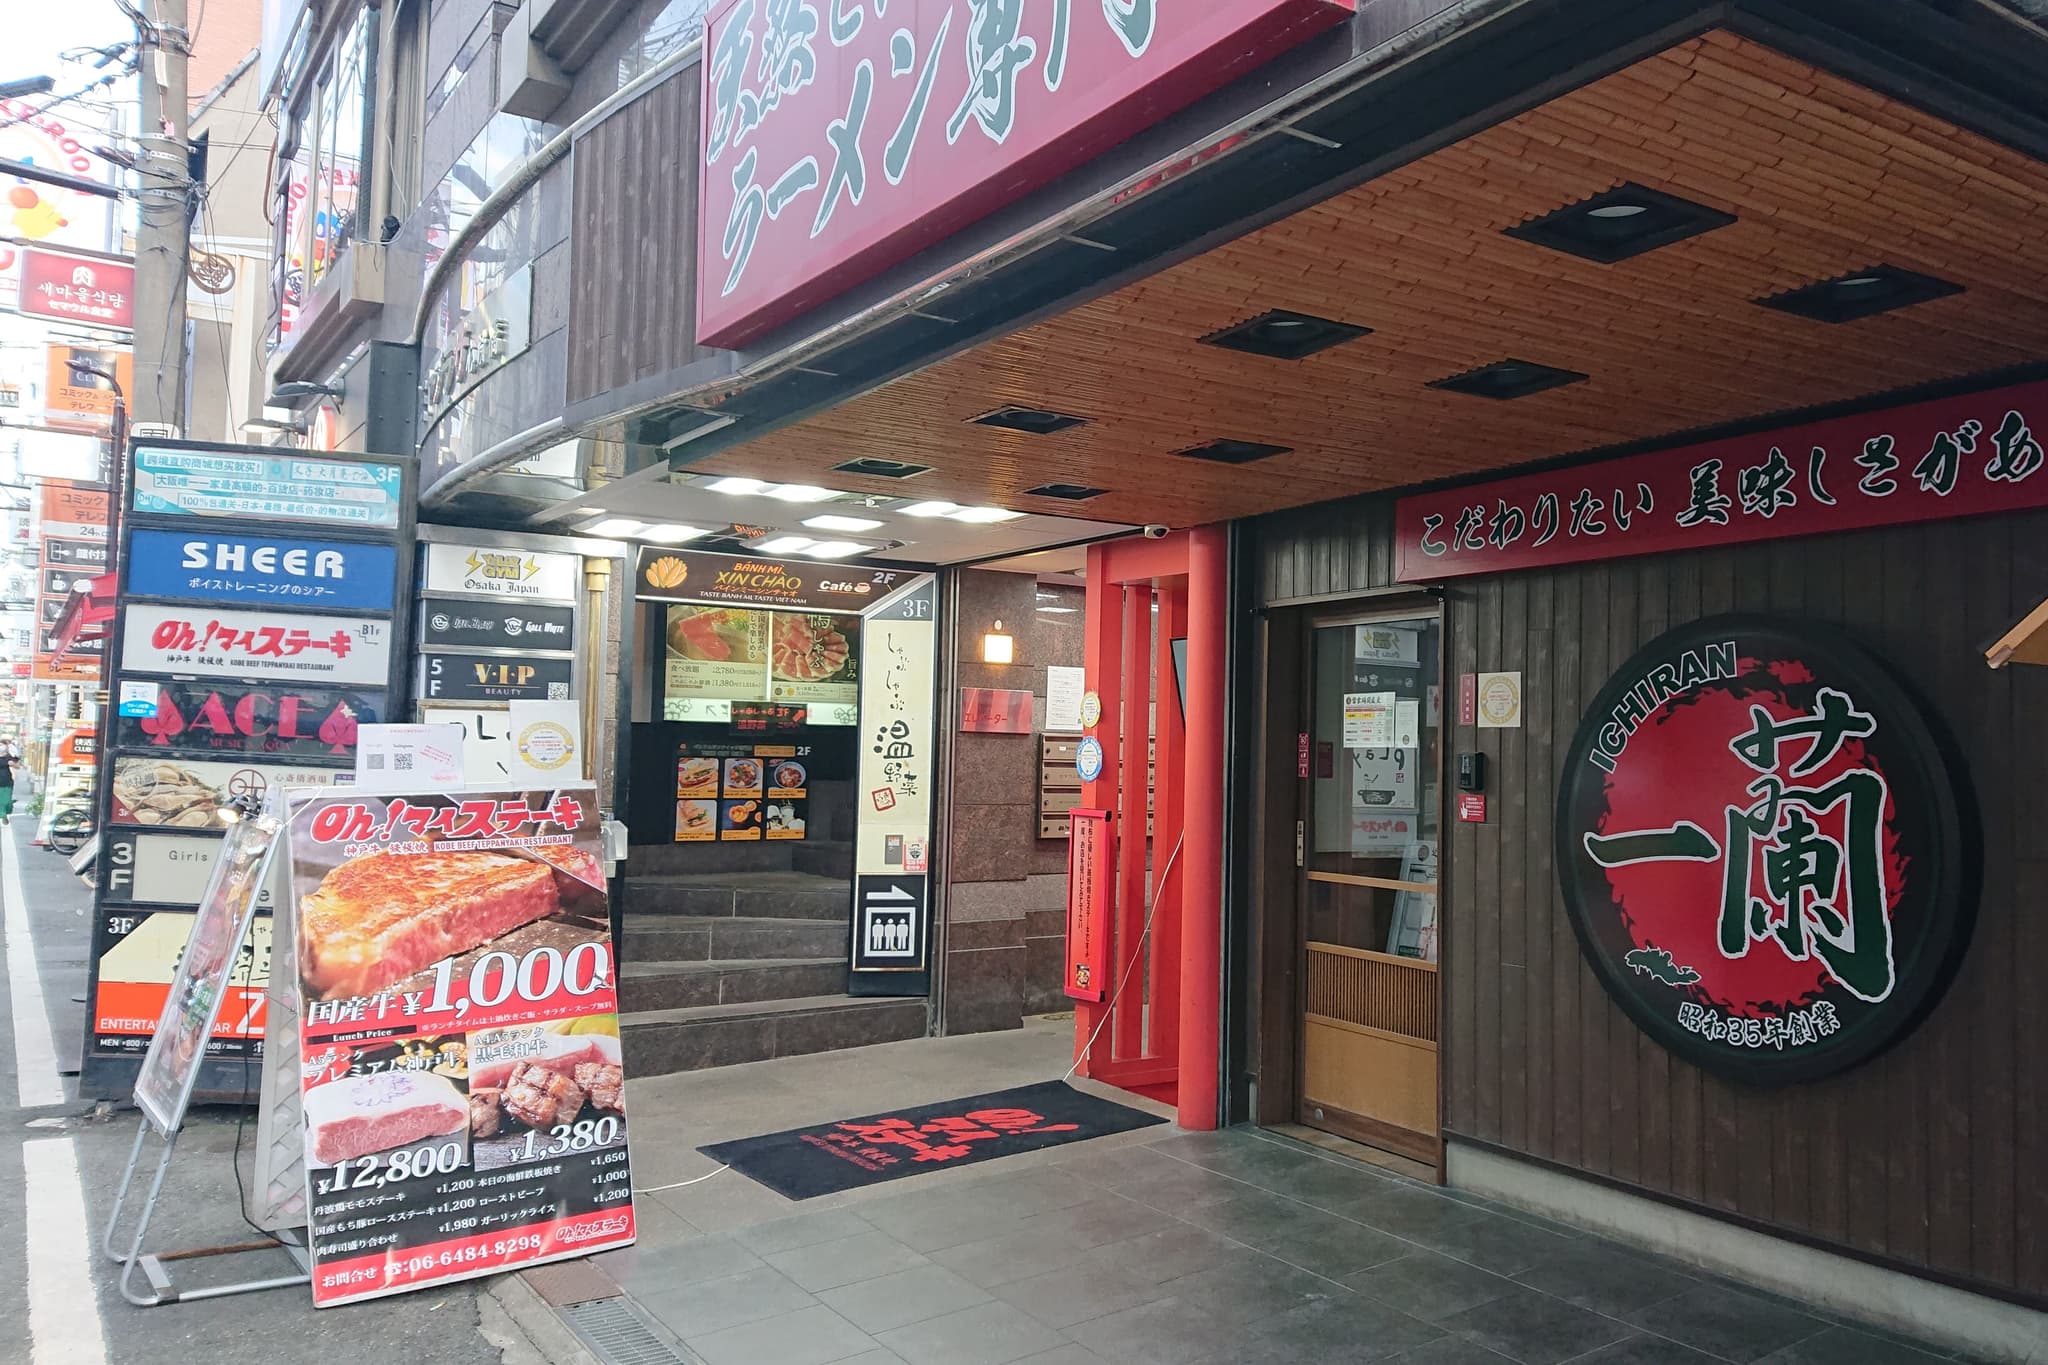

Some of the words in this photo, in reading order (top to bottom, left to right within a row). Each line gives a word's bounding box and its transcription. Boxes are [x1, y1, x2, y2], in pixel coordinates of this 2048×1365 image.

[375, 467, 399, 482] 3F
[1676, 409, 2045, 528] 美味しさがあ
[1419, 482, 1655, 557] こだわりたい
[182, 541, 345, 579] SHEER
[464, 579, 501, 592] Osaka
[506, 582, 539, 594] Japan
[715, 571, 750, 586] XIN
[818, 580, 853, 593] Café
[872, 571, 896, 585] 2F
[902, 599, 930, 618] 3F
[485, 688, 522, 696] BEAUTY
[187, 690, 316, 740] ACE
[1589, 640, 1738, 775] ICHIRAN
[796, 746, 812, 756] 2F
[435, 840, 454, 851] KOBE
[456, 839, 475, 850] BEEF
[476, 838, 523, 849] TEPPANYAKI
[523, 835, 573, 847] RESTAURANT
[1583, 686, 1895, 1003] 一蘭
[168, 850, 209, 862] Girls
[108, 917, 132, 934] 3F
[306, 991, 397, 1027] 国産牛
[100, 1017, 159, 1030] ENTERTA
[1678, 1000, 1841, 1051] 昭和35年創業
[100, 1039, 119, 1047] MEN
[333, 1031, 365, 1042] Lunch
[367, 1029, 392, 1039] Price
[475, 1040, 549, 1065] 黒毛和牛
[305, 1051, 462, 1085] プレミアム神戸牛
[590, 1152, 626, 1167] ¥1,650
[436, 1179, 474, 1195] ¥1,200
[479, 1187, 545, 1207] ローストビーフ
[592, 1170, 628, 1185] ¥1,000
[437, 1198, 475, 1215] ¥1,200
[480, 1204, 556, 1227] ガーリックライス
[593, 1188, 629, 1204] ¥1,200
[438, 1217, 477, 1234] ¥1,980
[322, 1265, 378, 1288] お問合せ
